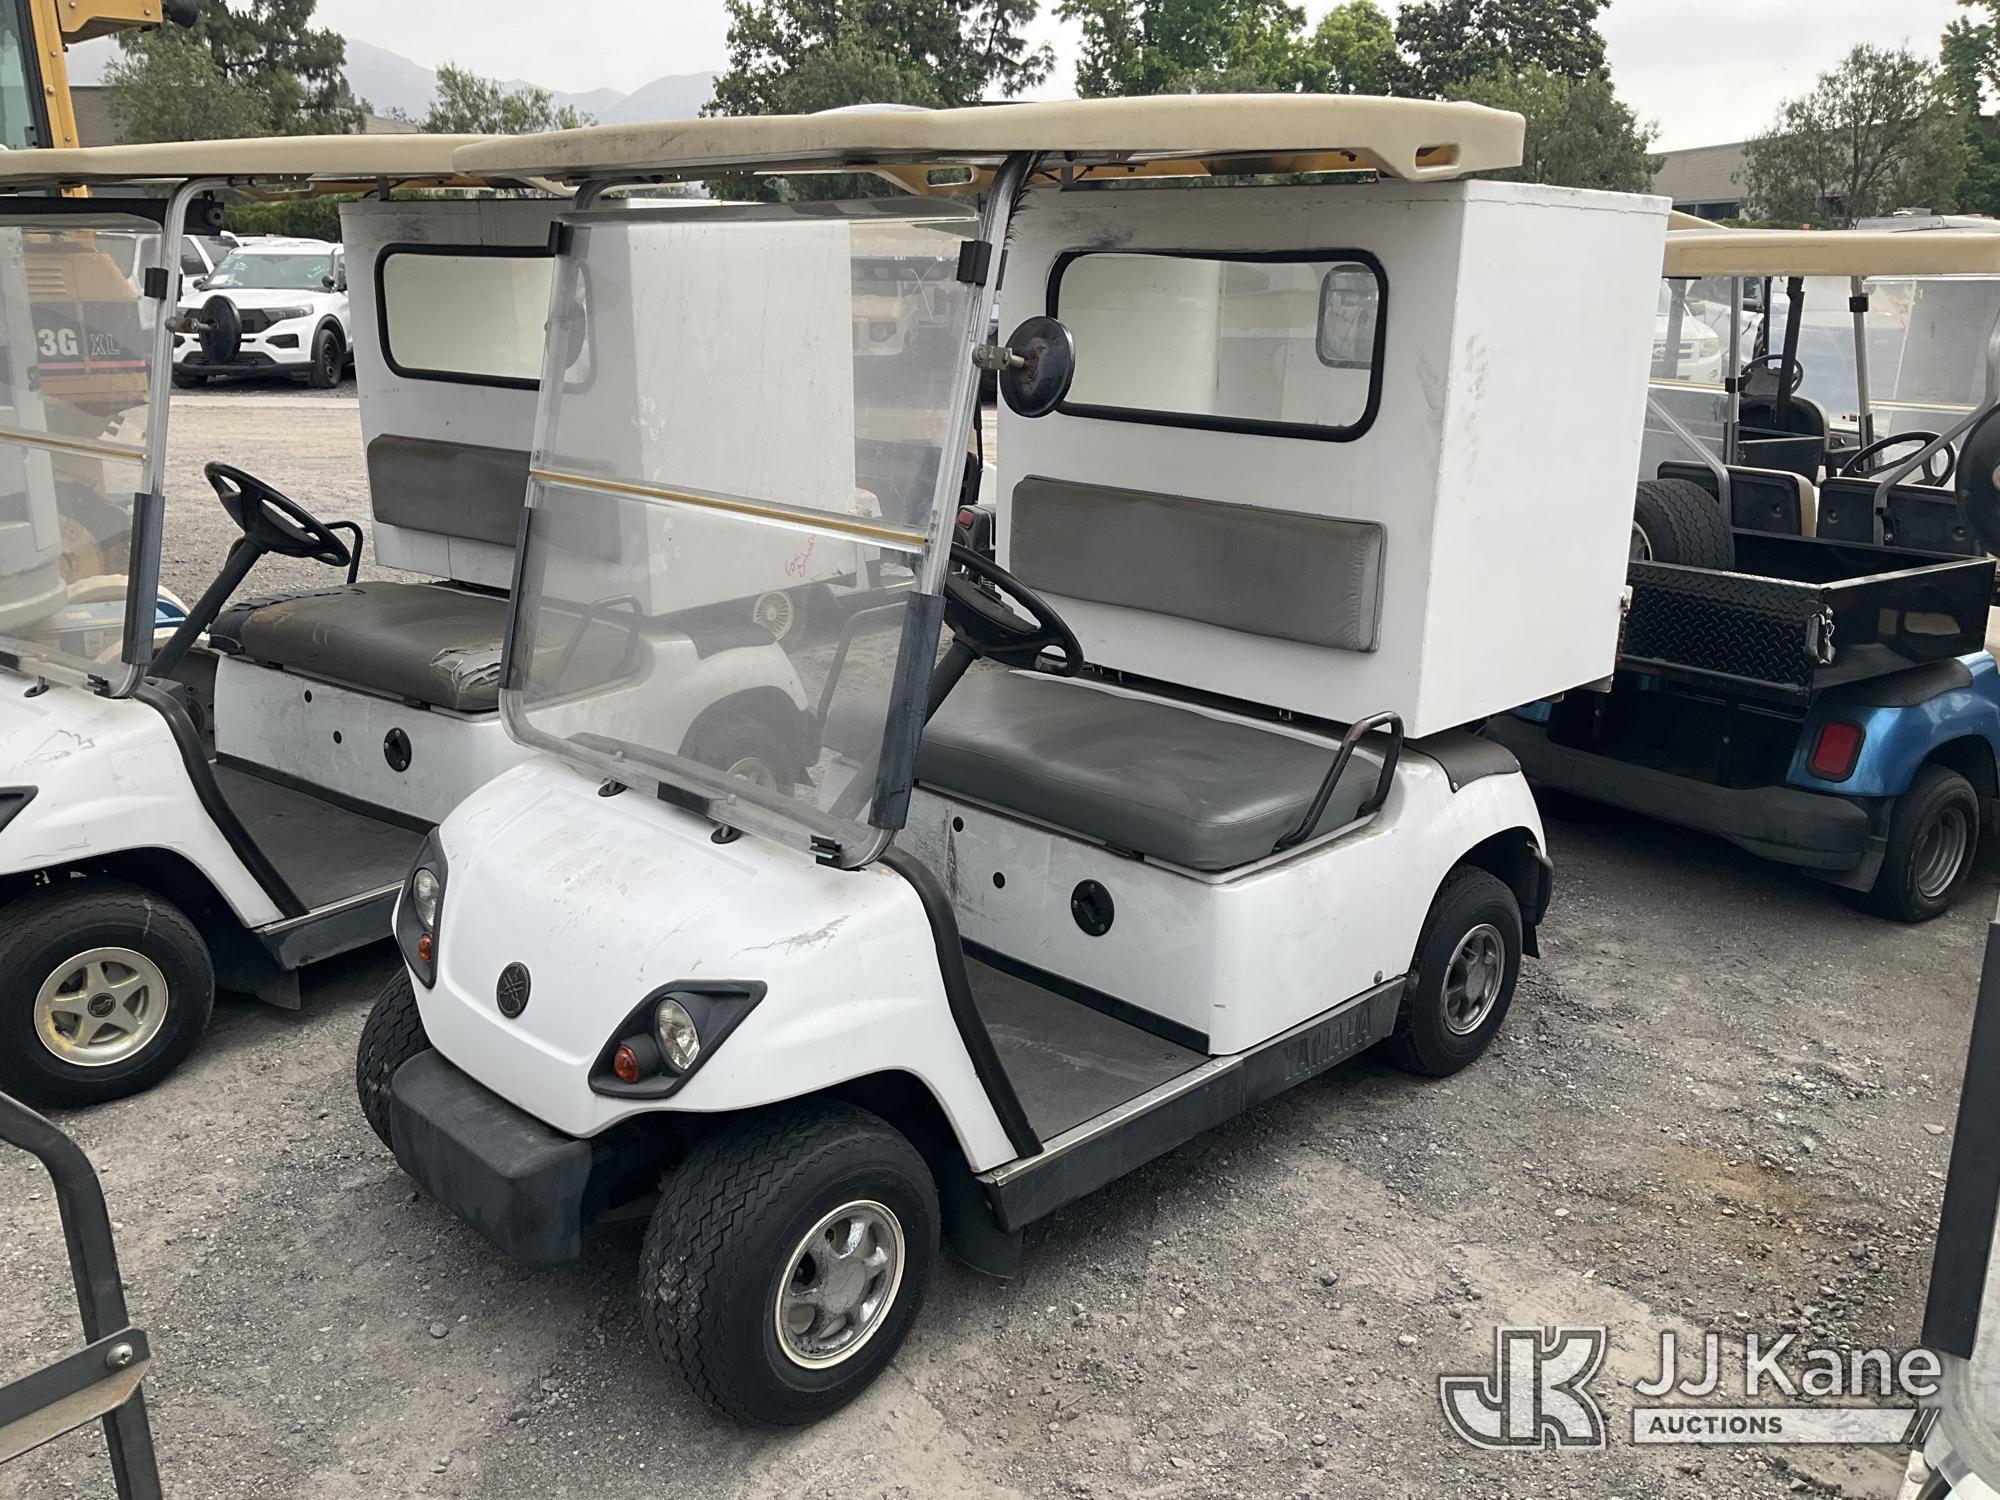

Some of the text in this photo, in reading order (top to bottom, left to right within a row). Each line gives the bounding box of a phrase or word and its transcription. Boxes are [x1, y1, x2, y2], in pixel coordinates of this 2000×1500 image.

[38, 328, 120, 356] 3G XL
[1282, 1005, 1372, 1080] YAMAHA
